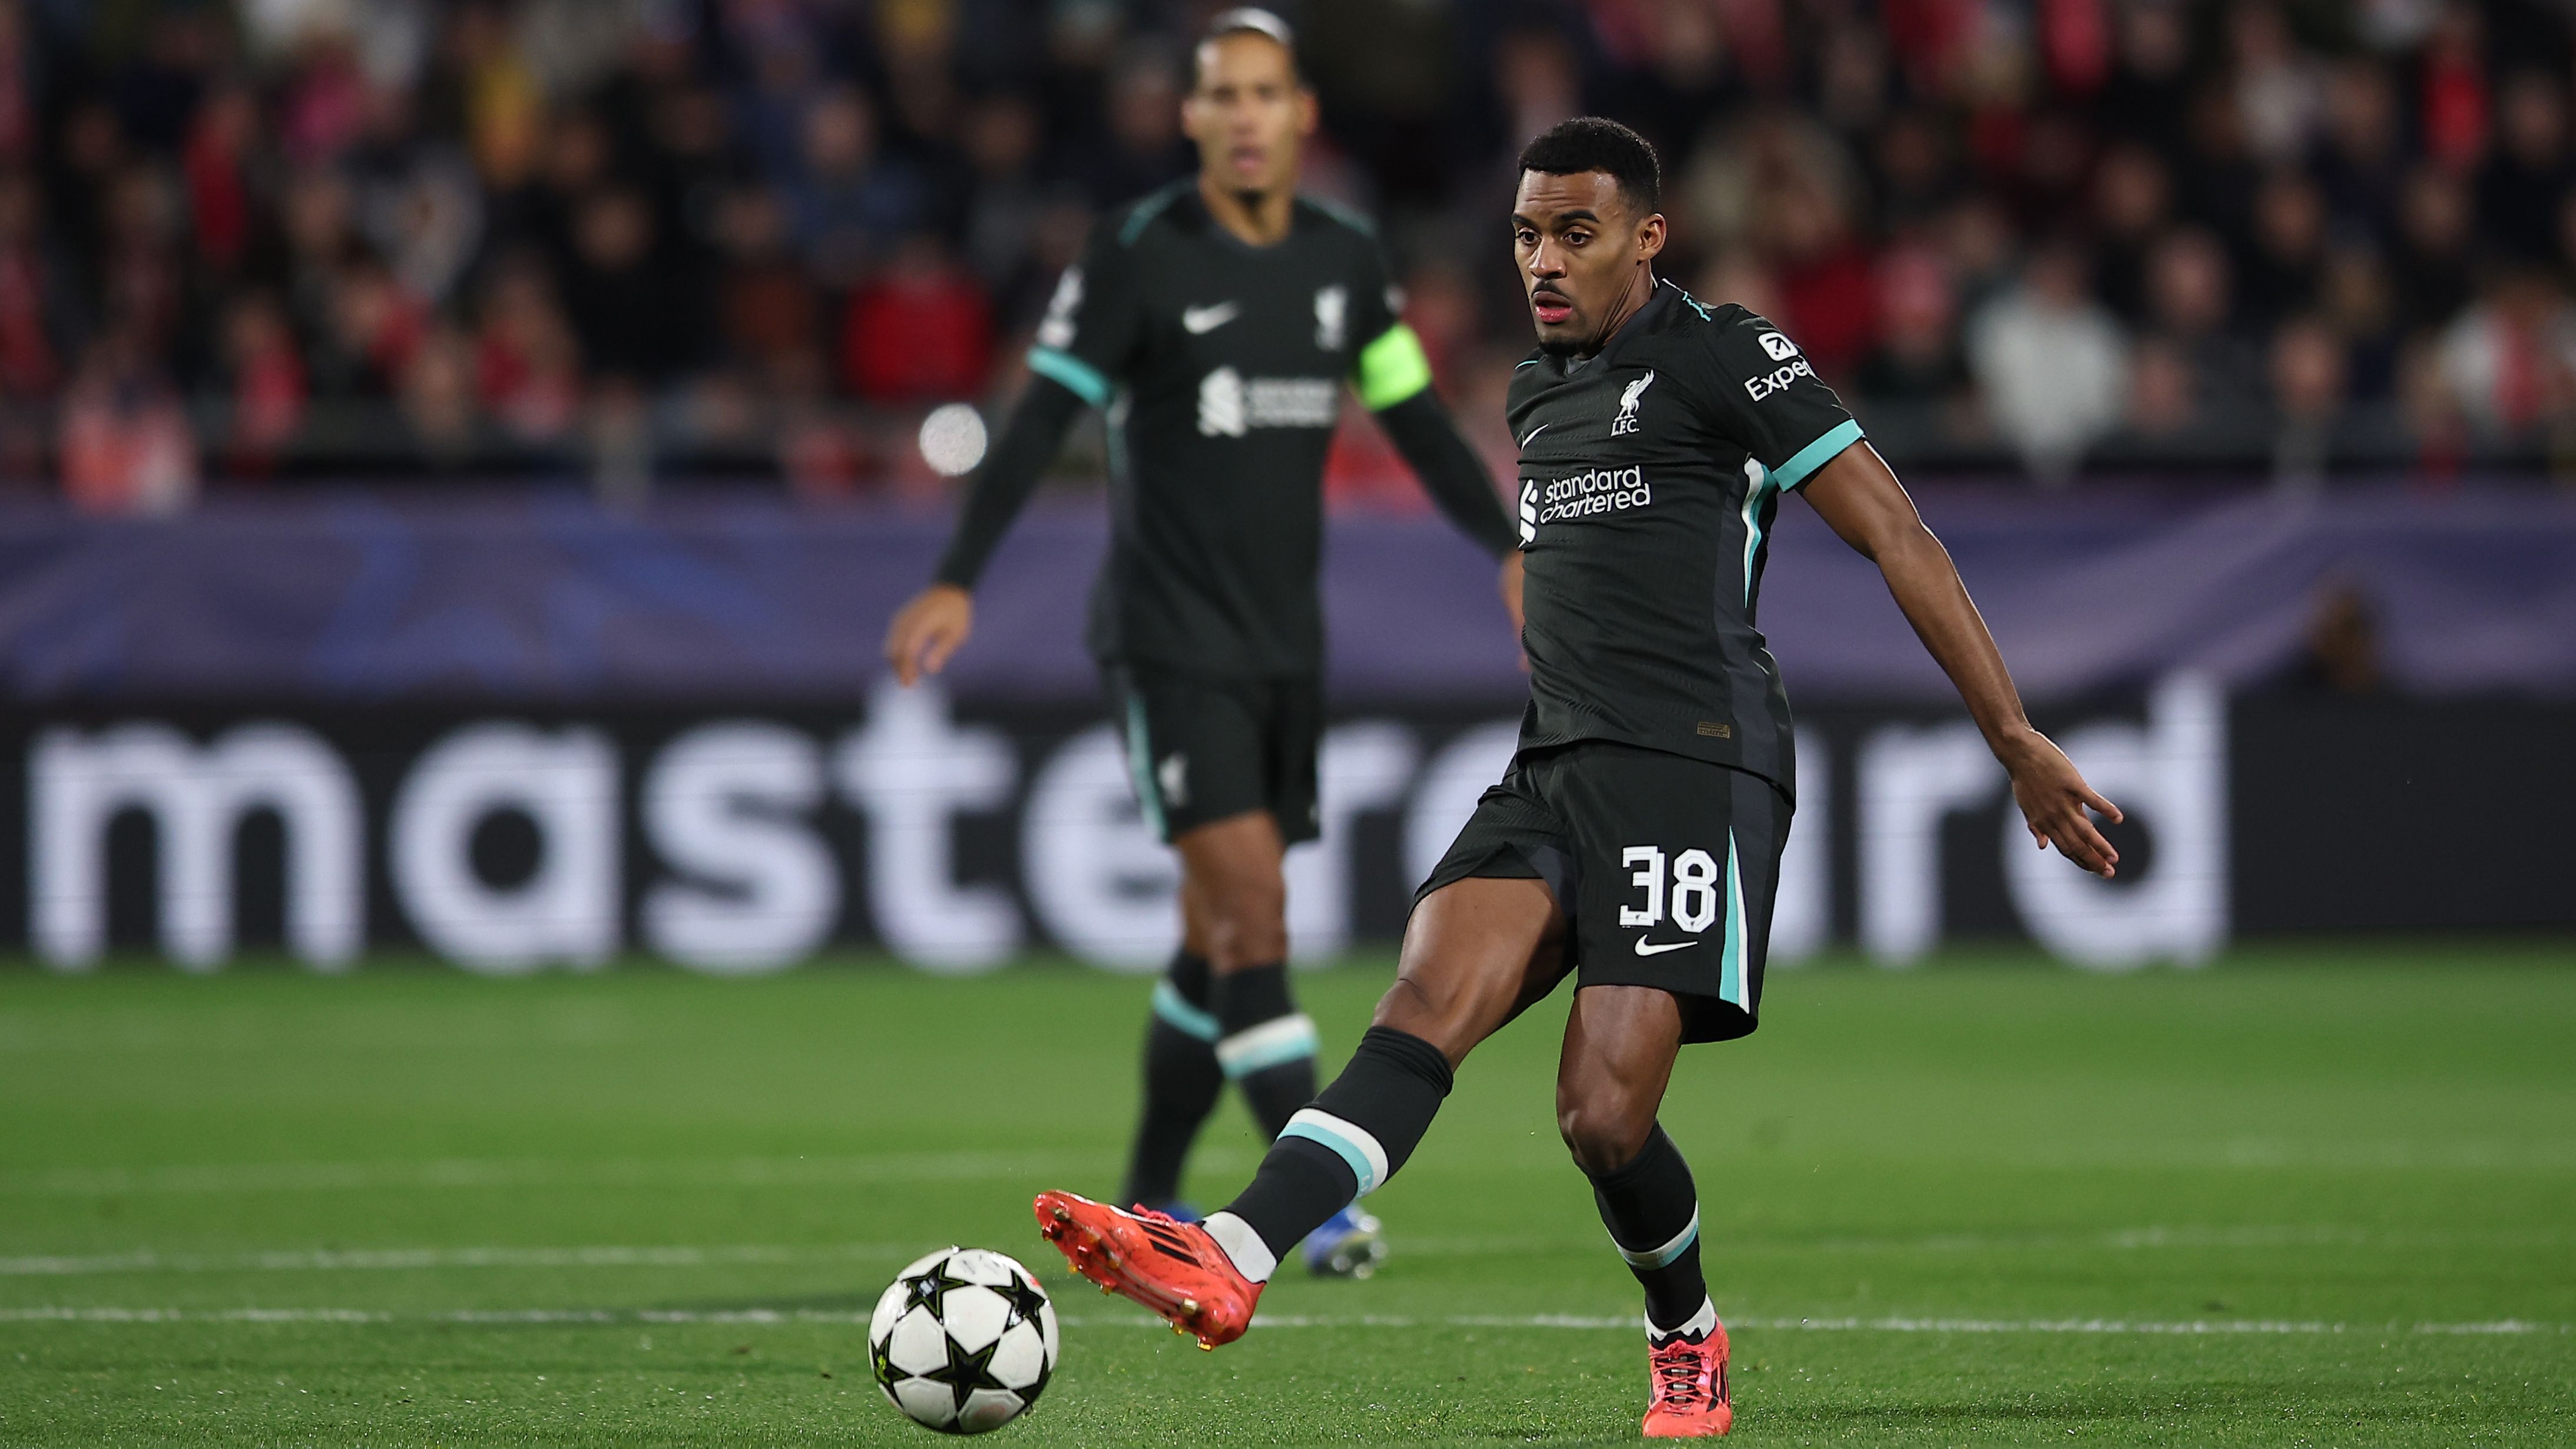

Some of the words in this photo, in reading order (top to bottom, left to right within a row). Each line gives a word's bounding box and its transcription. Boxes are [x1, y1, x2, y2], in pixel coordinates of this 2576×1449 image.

[1539, 482, 1651, 524] chartered
[1544, 465, 1641, 504] standard
[1619, 845, 1718, 934] 38
